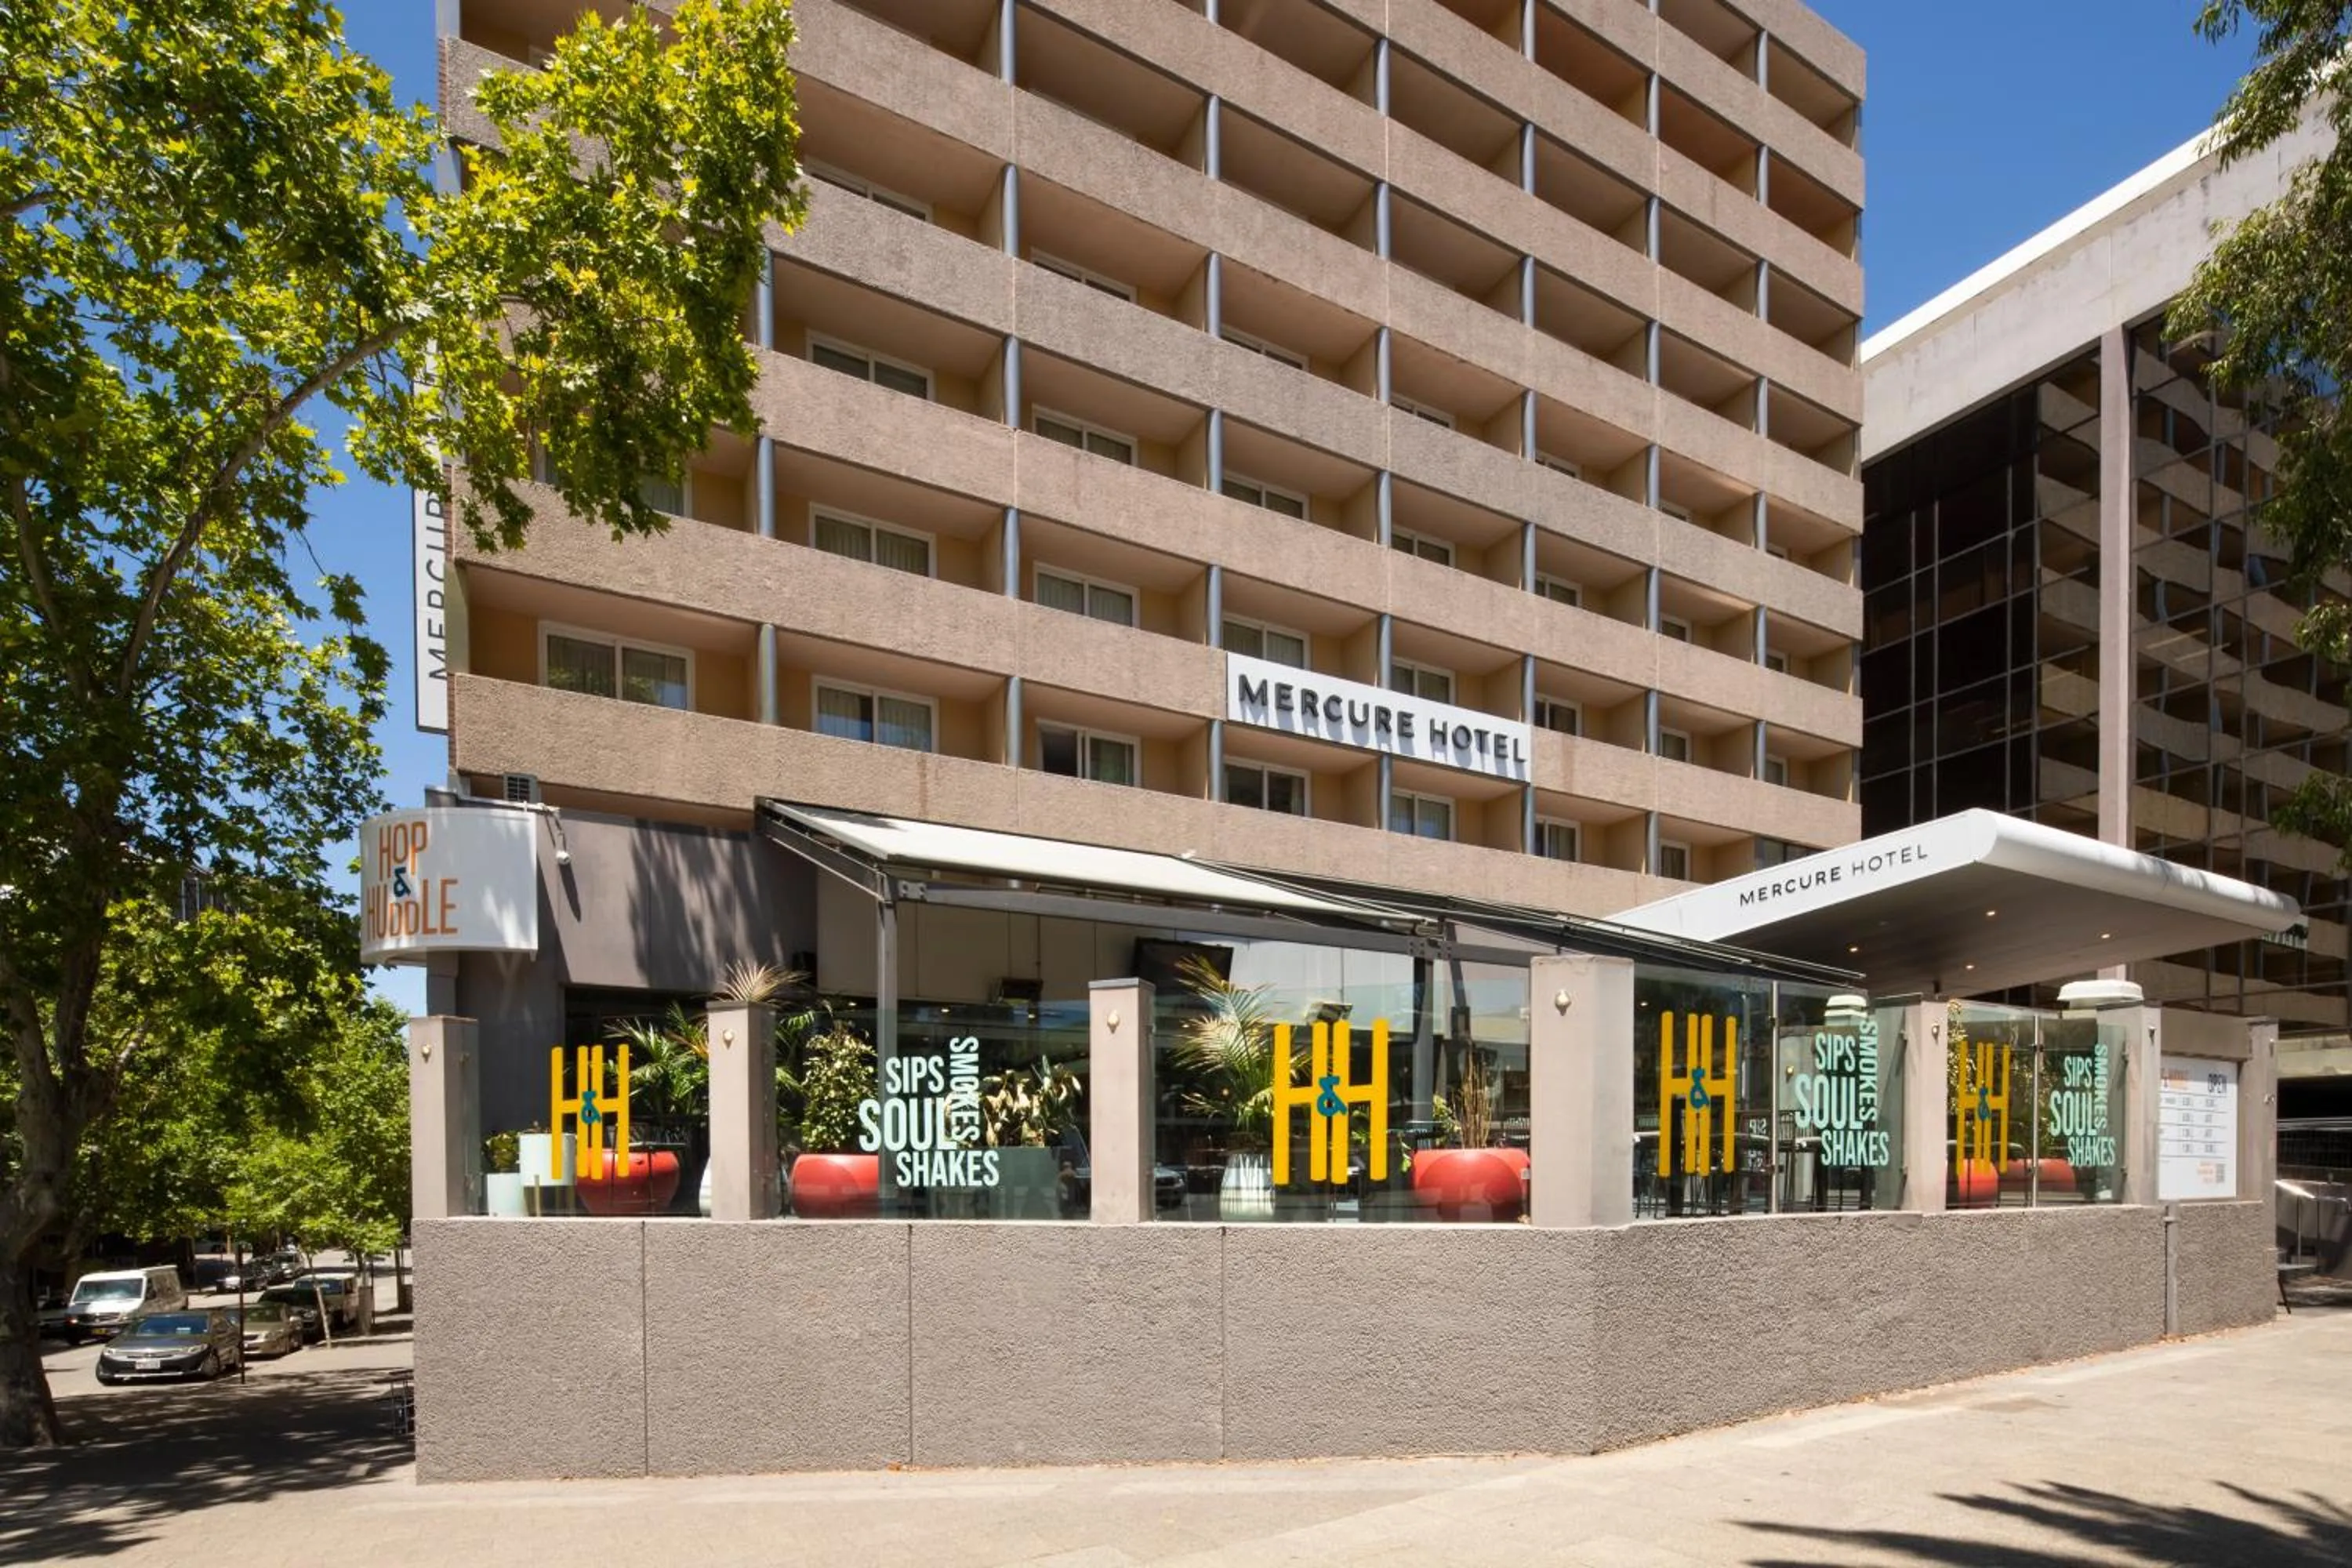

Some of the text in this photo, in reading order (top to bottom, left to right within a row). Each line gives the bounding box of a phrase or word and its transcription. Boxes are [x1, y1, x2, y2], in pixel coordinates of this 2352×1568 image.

[1238, 673, 1526, 764] MERCURE HOTEL
[379, 821, 428, 882] HOP
[1739, 844, 1929, 907] MERCURE HOTEL
[394, 866, 412, 898] &
[366, 877, 459, 942] HUDDLE
[885, 1055, 946, 1094] SIPS
[1815, 1032, 1857, 1073] SIPS
[1858, 1019, 1879, 1123] SMOKES
[2063, 1054, 2093, 1087] SIPS
[949, 1036, 980, 1142] SMOKES
[1793, 1074, 1864, 1131] SOUL
[2049, 1090, 2096, 1136] SOUL
[2095, 1044, 2108, 1135] SMOKES
[858, 1098, 958, 1152] SOUL
[1820, 1130, 1889, 1167] SHAKES
[2067, 1136, 2116, 1167] SHAKES
[895, 1151, 1000, 1187] SHAKES
